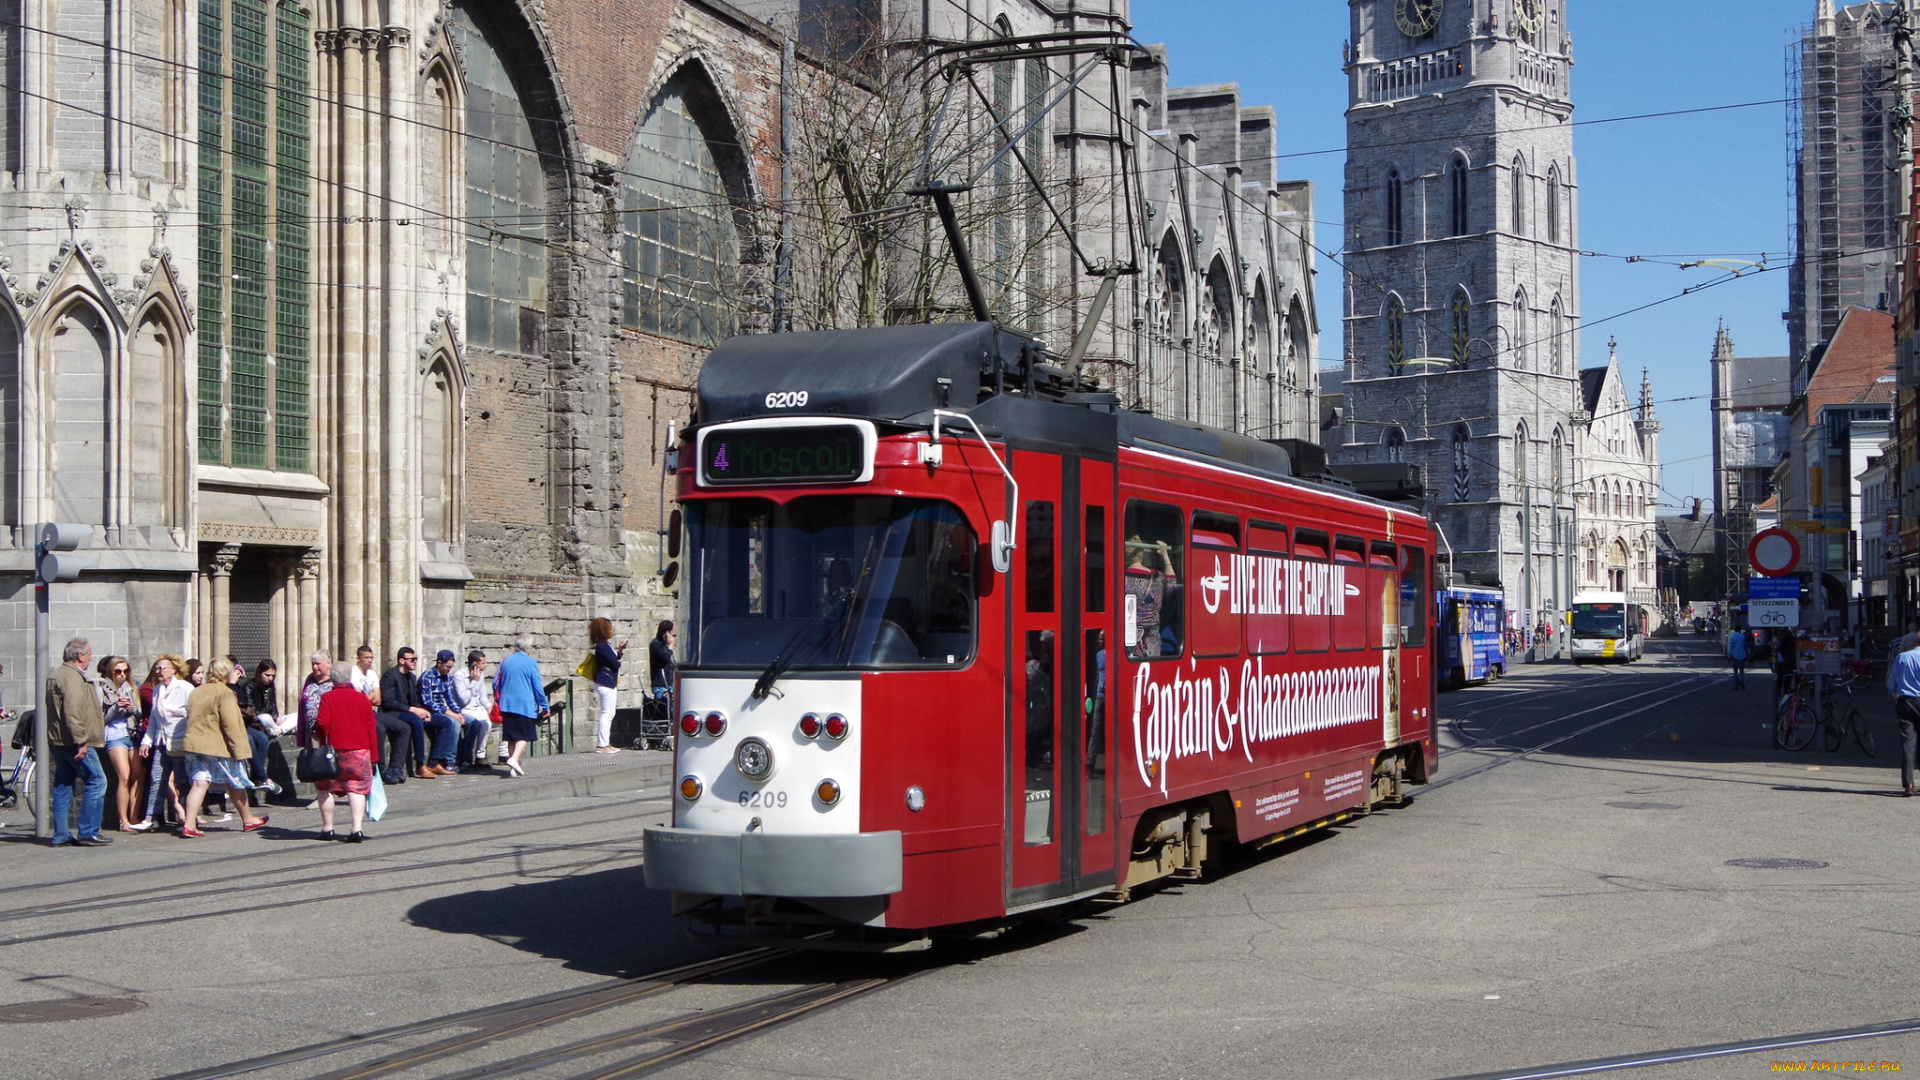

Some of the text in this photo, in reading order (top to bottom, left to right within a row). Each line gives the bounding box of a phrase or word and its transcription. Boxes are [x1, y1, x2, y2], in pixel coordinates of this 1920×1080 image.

[765, 391, 808, 409] 6209
[713, 443, 731, 471] 4
[1230, 554, 1345, 616] LIVE LIKE THE CAPTAIN
[1133, 651, 1213, 799] Captain
[1215, 666, 1239, 752] &
[738, 791, 788, 808] 6209
